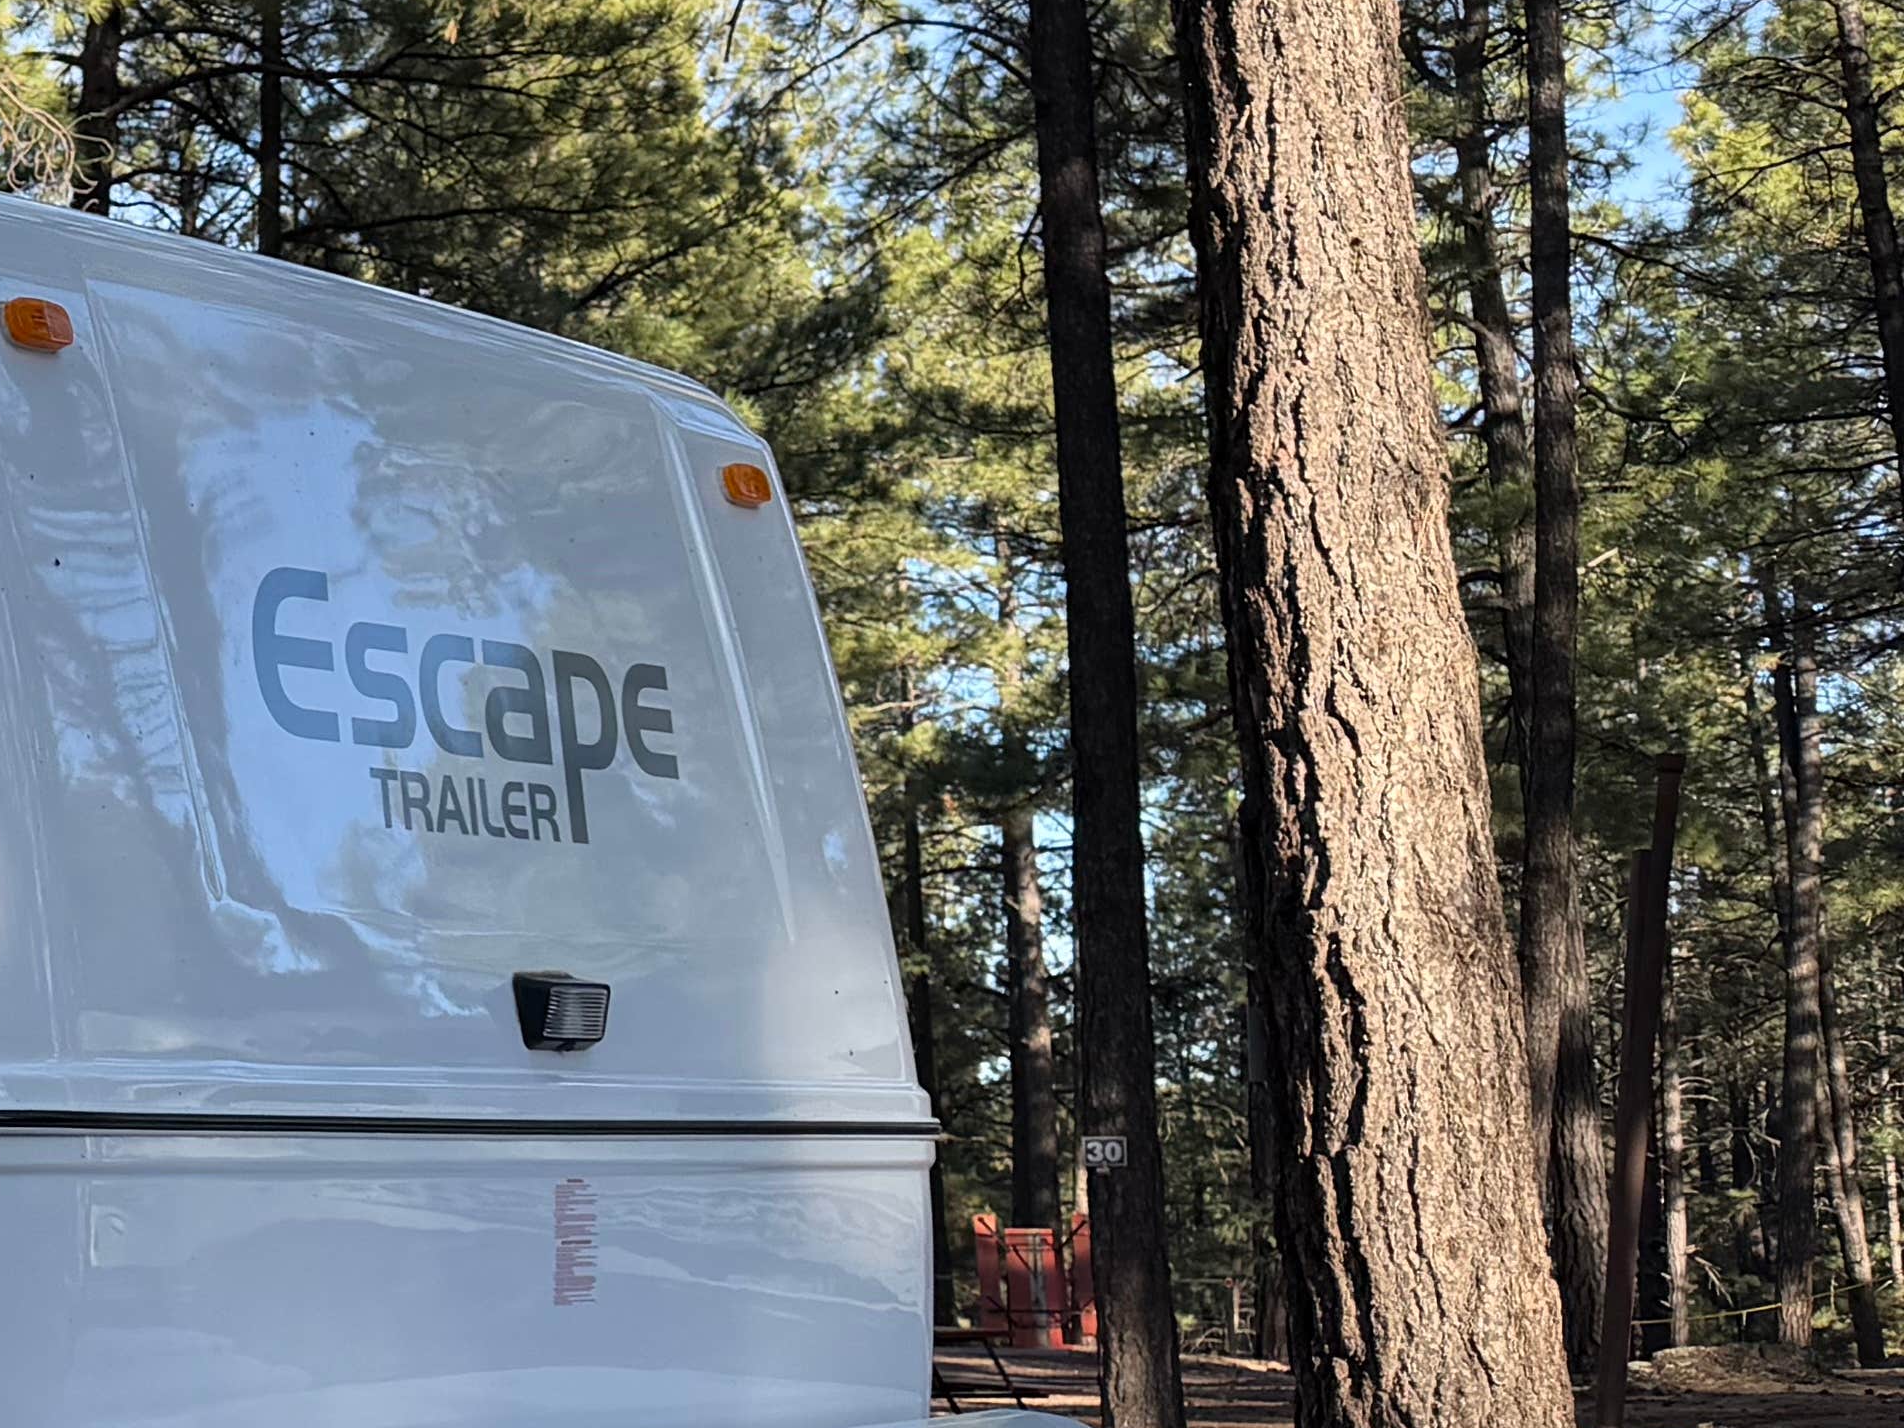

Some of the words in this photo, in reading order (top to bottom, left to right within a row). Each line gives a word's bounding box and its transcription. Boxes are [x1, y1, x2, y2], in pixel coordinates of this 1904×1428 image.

[252, 566, 680, 845] Escape
[369, 766, 561, 843] TRAILER
[1087, 1141, 1122, 1163] 30
